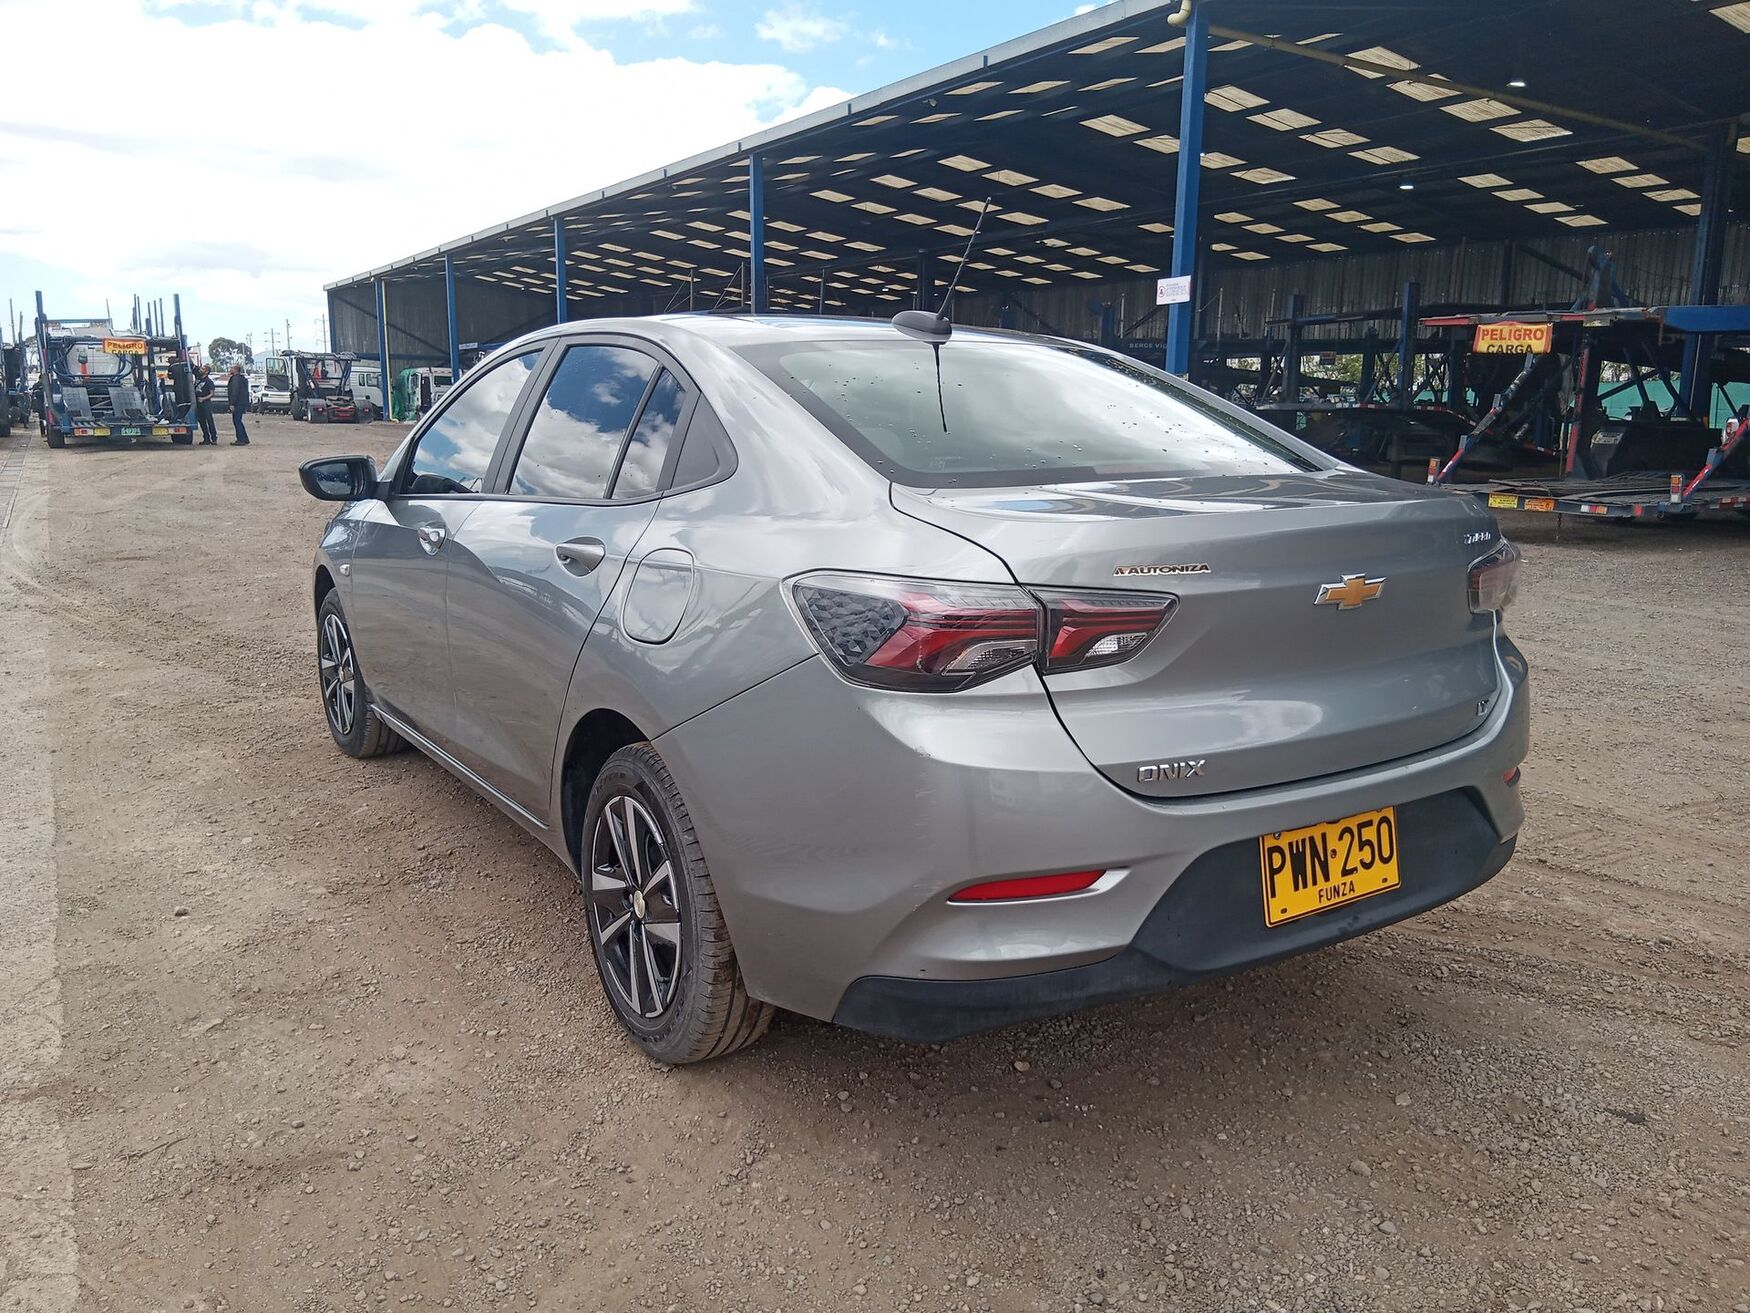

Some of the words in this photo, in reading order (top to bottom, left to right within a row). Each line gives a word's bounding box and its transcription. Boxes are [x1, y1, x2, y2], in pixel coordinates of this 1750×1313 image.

[1481, 328, 1544, 341] PELIGRO
[107, 341, 143, 350] PELIGRO
[1486, 344, 1534, 354] CARGA
[1128, 564, 1210, 575] AUTONIZA
[1137, 759, 1206, 783] ONIX
[1266, 832, 1330, 899] PWN
[1338, 815, 1394, 877] 250
[1318, 880, 1355, 903] FUNZA
